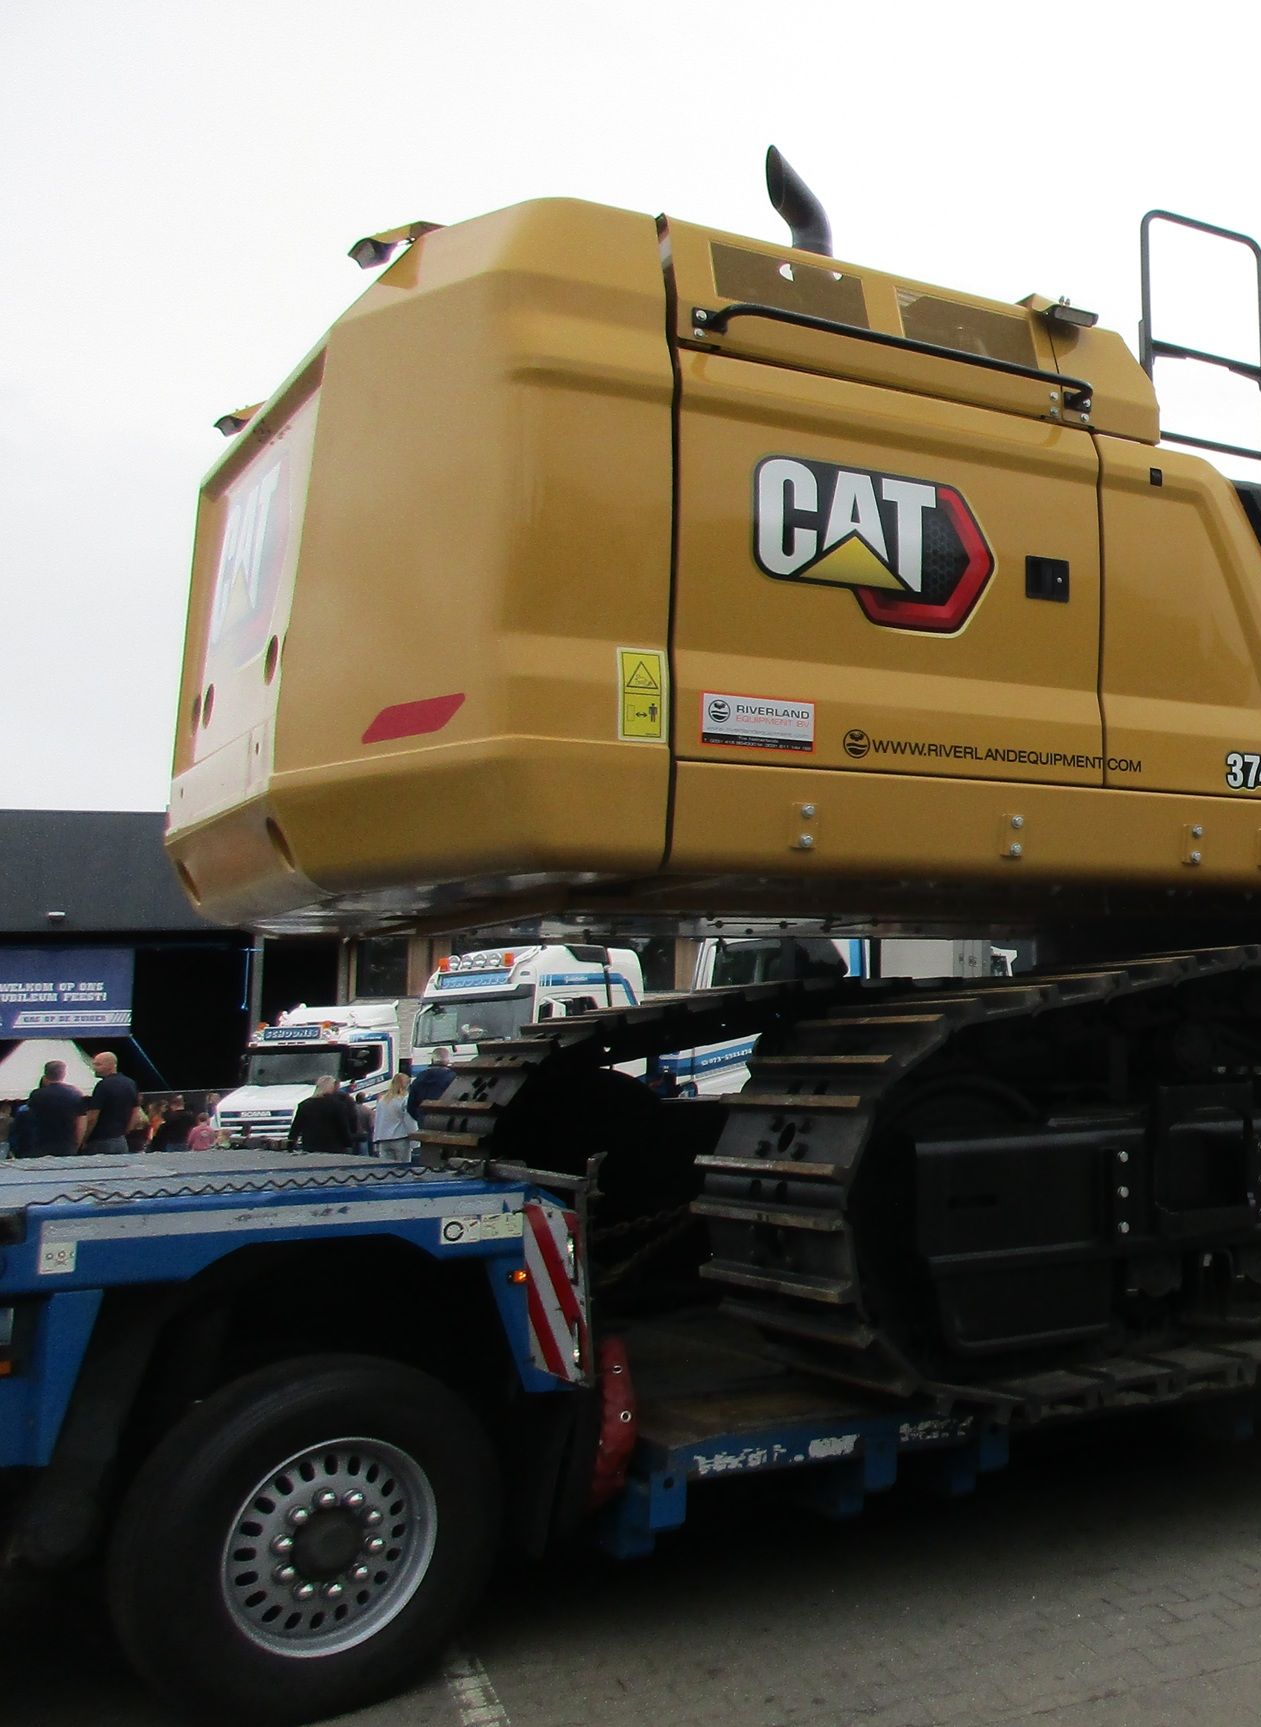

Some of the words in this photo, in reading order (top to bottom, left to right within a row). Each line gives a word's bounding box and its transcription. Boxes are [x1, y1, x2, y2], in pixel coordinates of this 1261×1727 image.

[758, 458, 937, 593] CAT
[736, 704, 810, 720] RIVERLAND
[736, 714, 792, 727] EQUIPMENT
[796, 719, 810, 729] BV
[871, 738, 1142, 773] WWW.RIVERLANDEQUIPMENTCOM
[0, 982, 54, 992] WELKOM
[59, 982, 76, 992] OP
[80, 982, 105, 992] ONS
[0, 992, 58, 1002] UBILEUM
[62, 992, 107, 1002] FEEST!
[240, 1110, 272, 1118] SCANIA
